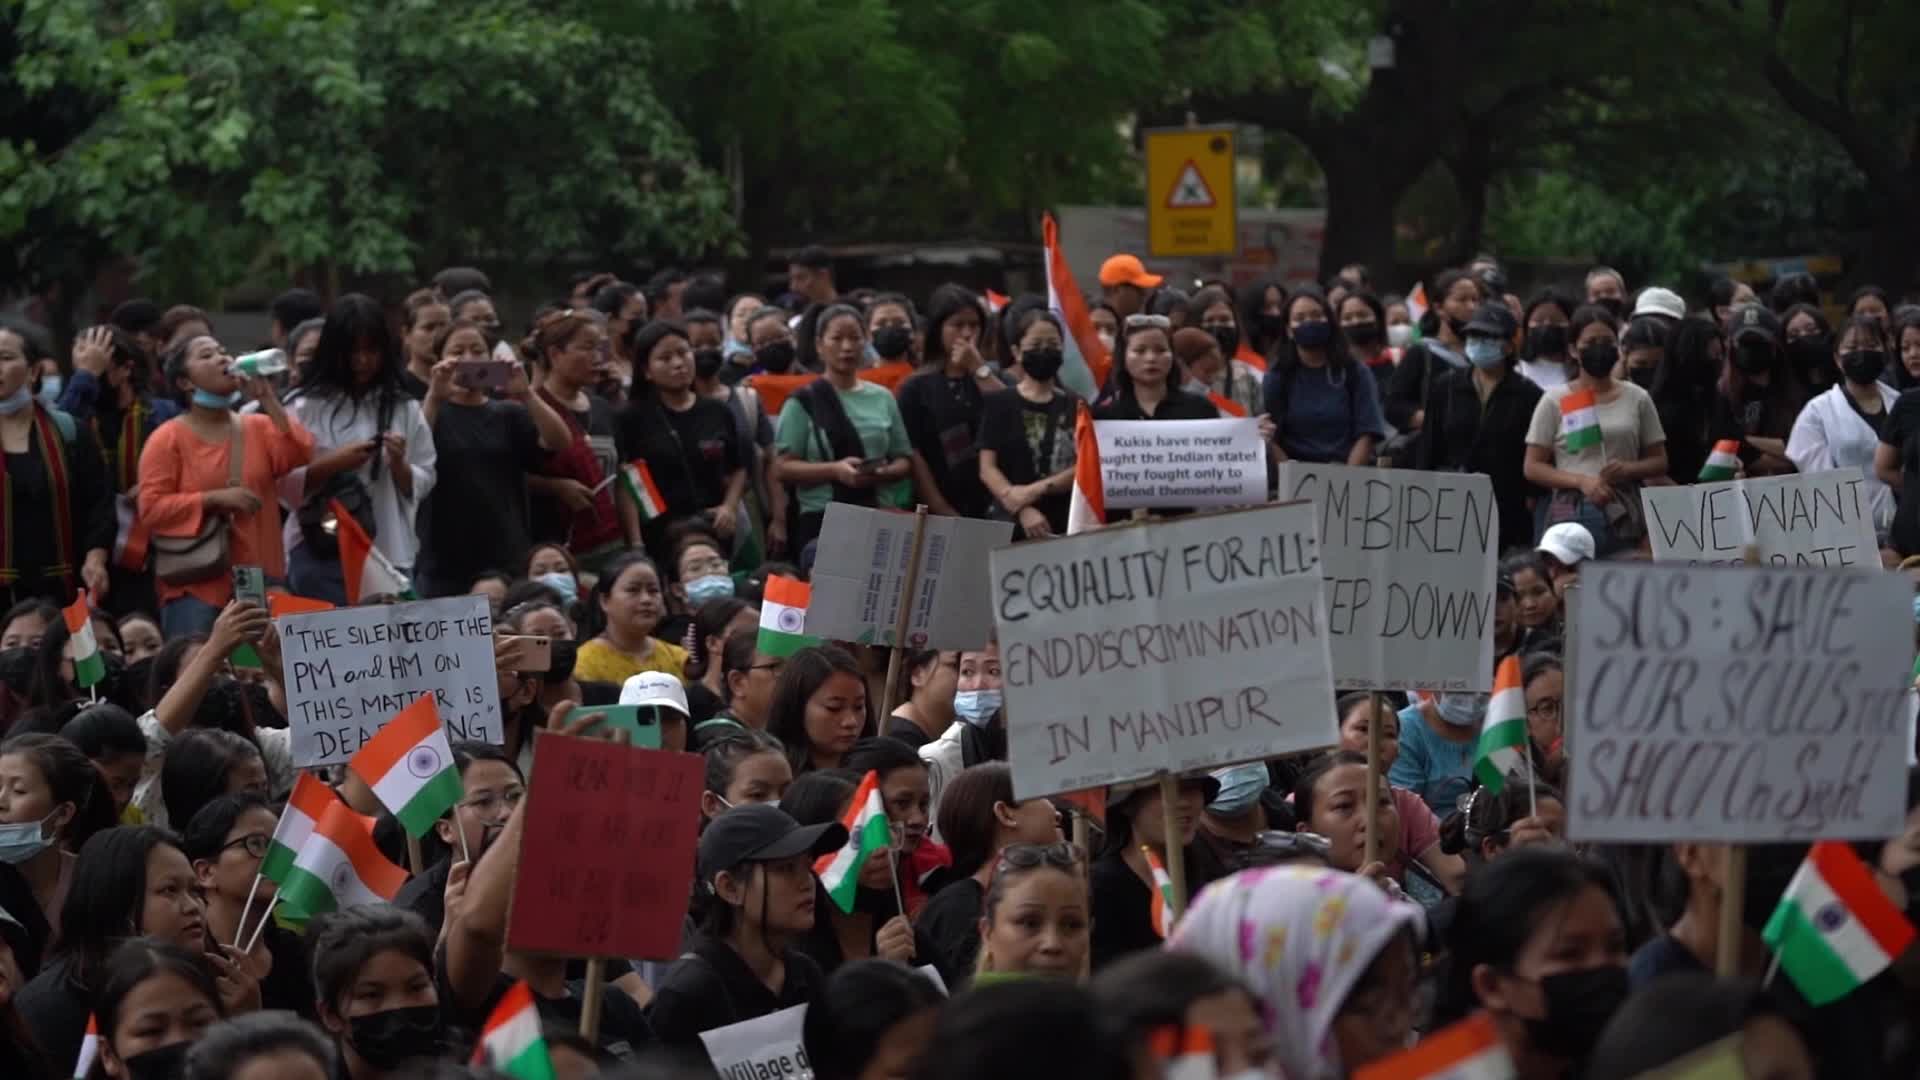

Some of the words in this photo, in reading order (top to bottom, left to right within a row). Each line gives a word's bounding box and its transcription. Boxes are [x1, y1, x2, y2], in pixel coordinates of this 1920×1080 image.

[1114, 436, 1152, 448] Kukis
[1156, 435, 1190, 446] have
[1194, 437, 1232, 446] never
[1141, 452, 1164, 462] the
[1168, 451, 1213, 462] Indian
[1217, 451, 1257, 462] state!
[1106, 468, 1140, 482] They
[1144, 467, 1189, 483] fought
[1193, 467, 1223, 481] only
[1228, 467, 1243, 479] to
[1106, 485, 1155, 497] defend
[1159, 484, 1243, 497] themselves!
[1650, 487, 1737, 552] WE
[1742, 480, 1864, 536] WANT
[1001, 548, 1169, 622] EQUALITY
[453, 616, 491, 637] THE
[1379, 582, 1491, 641] DOWN
[1593, 572, 1692, 653] SOS
[1729, 573, 1868, 656] SAVE
[294, 659, 336, 693] PM
[344, 655, 384, 684] and
[389, 653, 422, 680] HM
[435, 653, 460, 673] ON
[296, 697, 353, 725] THIS
[361, 688, 454, 715] MATTR
[465, 686, 484, 704] IS
[1583, 656, 1699, 737] OUR
[1702, 659, 1860, 737] SOULS
[1047, 716, 1090, 765] IN
[1109, 686, 1281, 752] MANIPUR
[1581, 740, 1733, 820] SHOOT
[722, 1055, 793, 1080] Village
